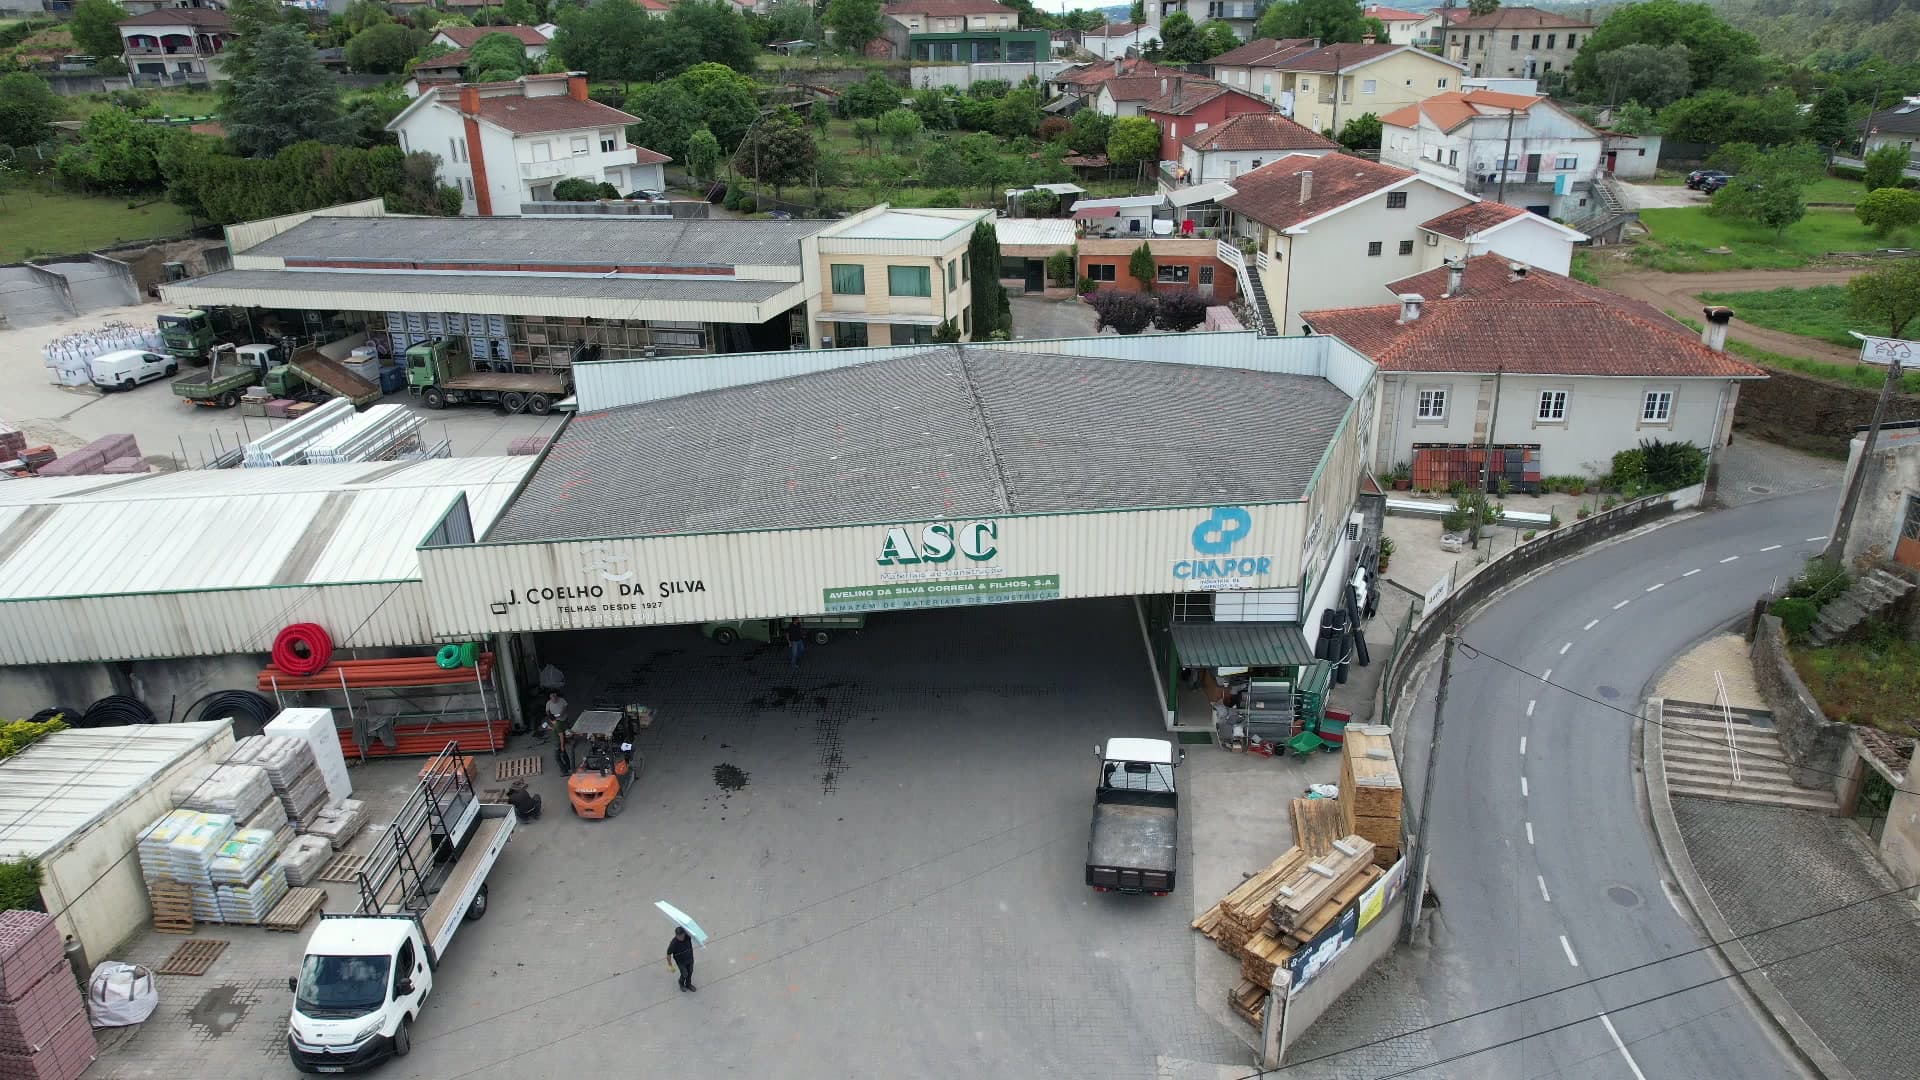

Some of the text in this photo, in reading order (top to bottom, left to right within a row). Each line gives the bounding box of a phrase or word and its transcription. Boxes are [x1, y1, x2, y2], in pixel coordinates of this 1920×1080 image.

[876, 520, 998, 566] ASC
[1173, 556, 1271, 579] CIMPOR
[508, 580, 706, 605] J. COELHO DA SILVA
[829, 590, 873, 599] AVELINO
[877, 588, 892, 596] DA
[896, 586, 924, 594] SILVA
[927, 583, 975, 593] CORREIA
[990, 580, 1030, 589] FILHOS,
[1034, 579, 1055, 587] S.A.
[558, 605, 597, 613] TELHAS
[602, 603, 637, 611] DESDE
[883, 601, 898, 609] DE
[903, 598, 961, 608] MATERIAIS
[988, 591, 1060, 603] CONSTRUÇÃO
